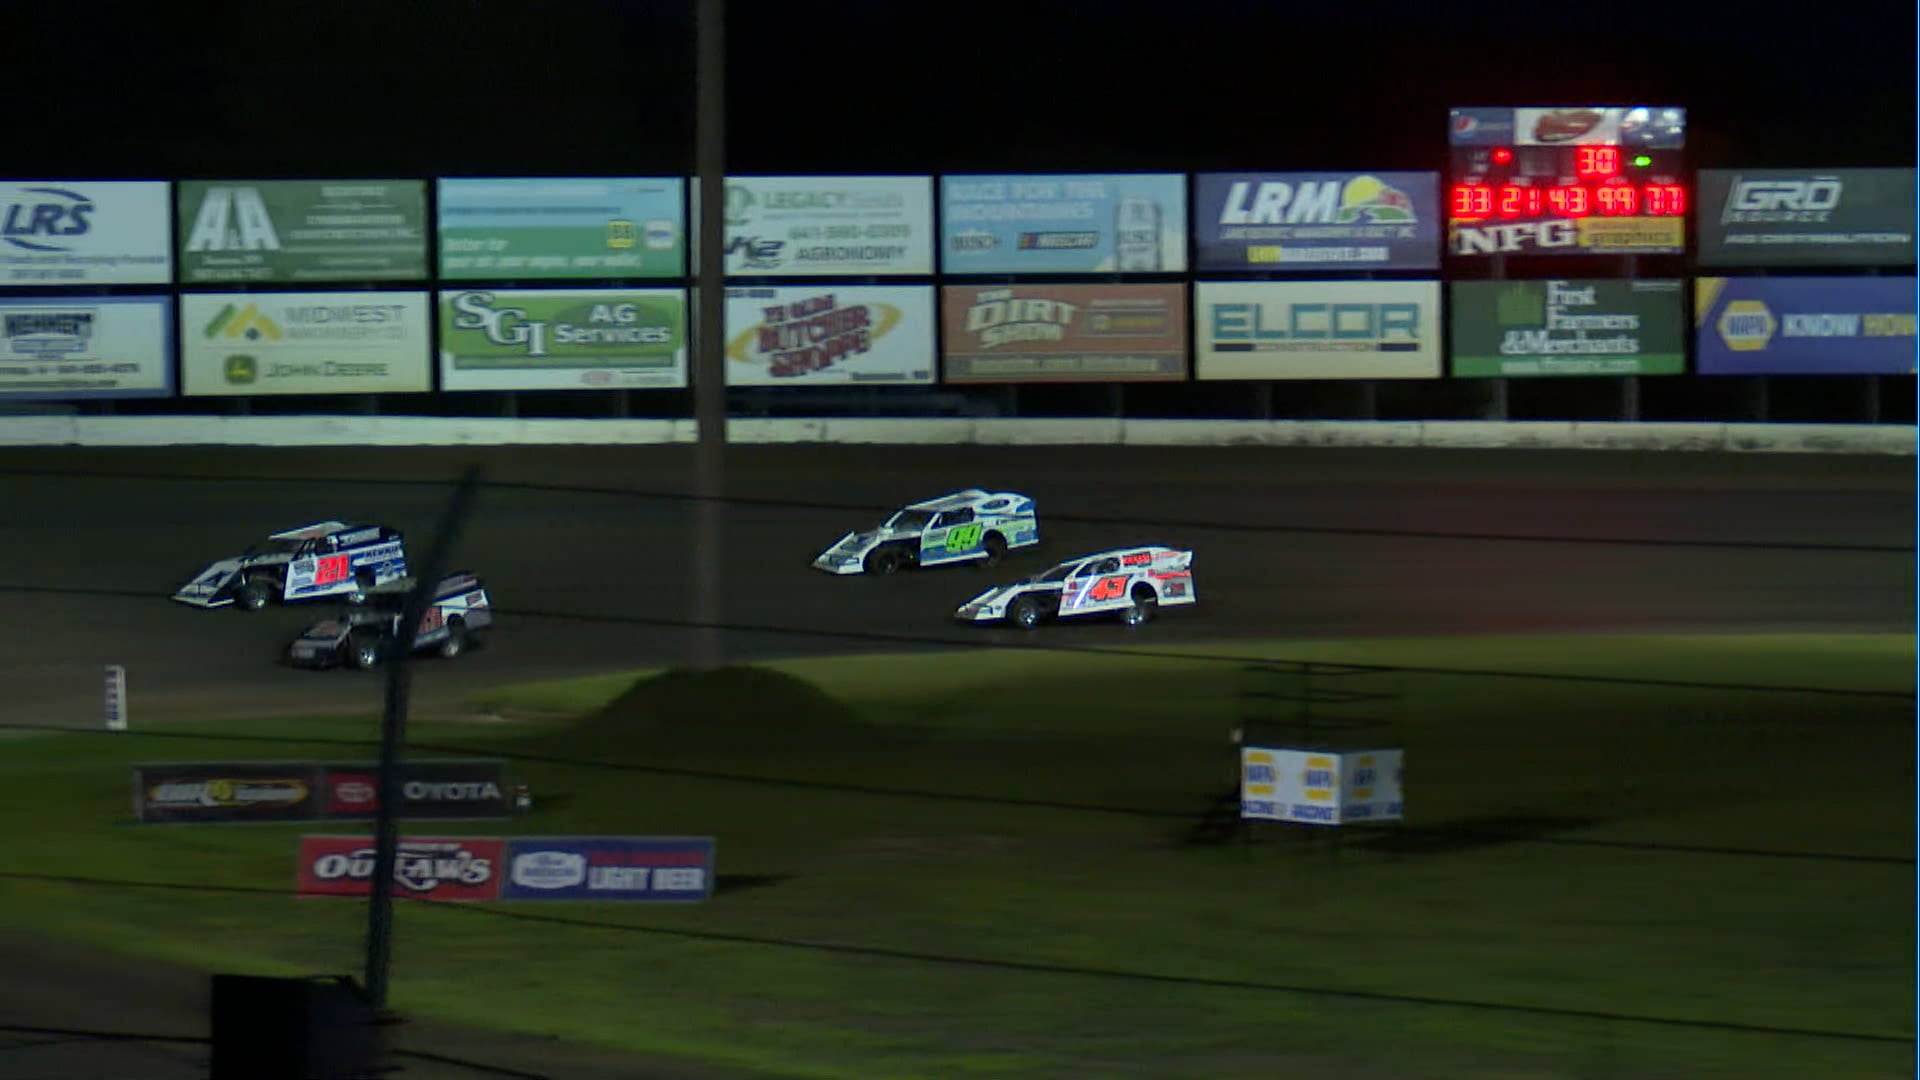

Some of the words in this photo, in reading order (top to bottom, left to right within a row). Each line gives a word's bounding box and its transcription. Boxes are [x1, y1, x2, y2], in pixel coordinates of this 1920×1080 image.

[1578, 148, 1619, 174] 30
[1219, 181, 1342, 224] LRM
[1454, 186, 1496, 213] 33
[1502, 186, 1543, 213] 21
[1549, 186, 1591, 213] 43
[1596, 187, 1638, 213] 99
[1645, 186, 1686, 214] 77
[2, 203, 94, 236] LRS
[1456, 218, 1577, 254] NFG
[1548, 280, 1597, 305] First
[454, 290, 547, 357] SGI
[589, 303, 637, 322] AG
[964, 299, 1078, 333] DIRT
[1211, 303, 1421, 339] ELCOR
[1548, 306, 1640, 330] Farmers
[1783, 314, 1859, 337] KNOW
[555, 324, 671, 343] Services
[403, 782, 501, 799] OYOTA
